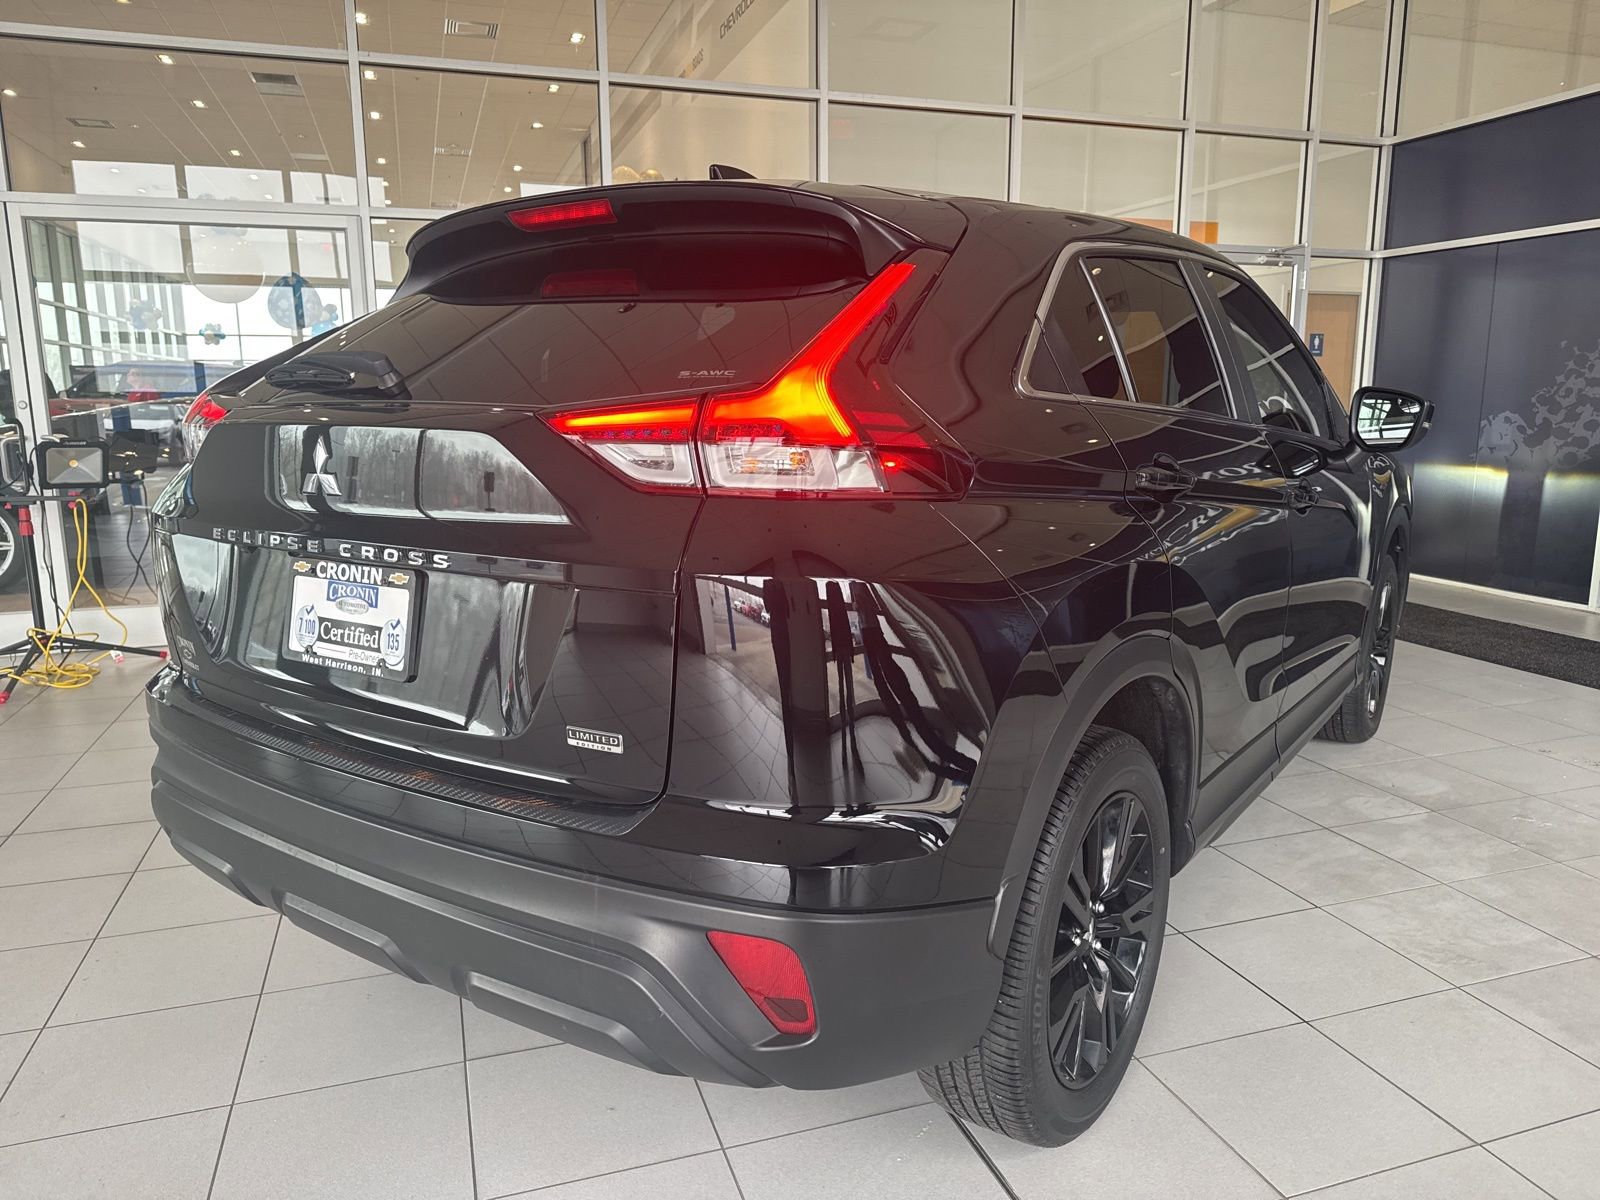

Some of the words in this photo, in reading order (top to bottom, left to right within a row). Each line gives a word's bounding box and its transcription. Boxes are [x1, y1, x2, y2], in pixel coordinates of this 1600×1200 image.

[212, 527, 322, 553] ECLIPSE
[339, 543, 450, 569] CROSS
[316, 561, 383, 585] CRONIN
[329, 583, 377, 607] CRONIN
[320, 621, 379, 649] Certified
[387, 632, 400, 652] 135
[302, 654, 323, 665] West
[568, 730, 618, 745] LIMITED
[576, 741, 612, 752] EDITION
